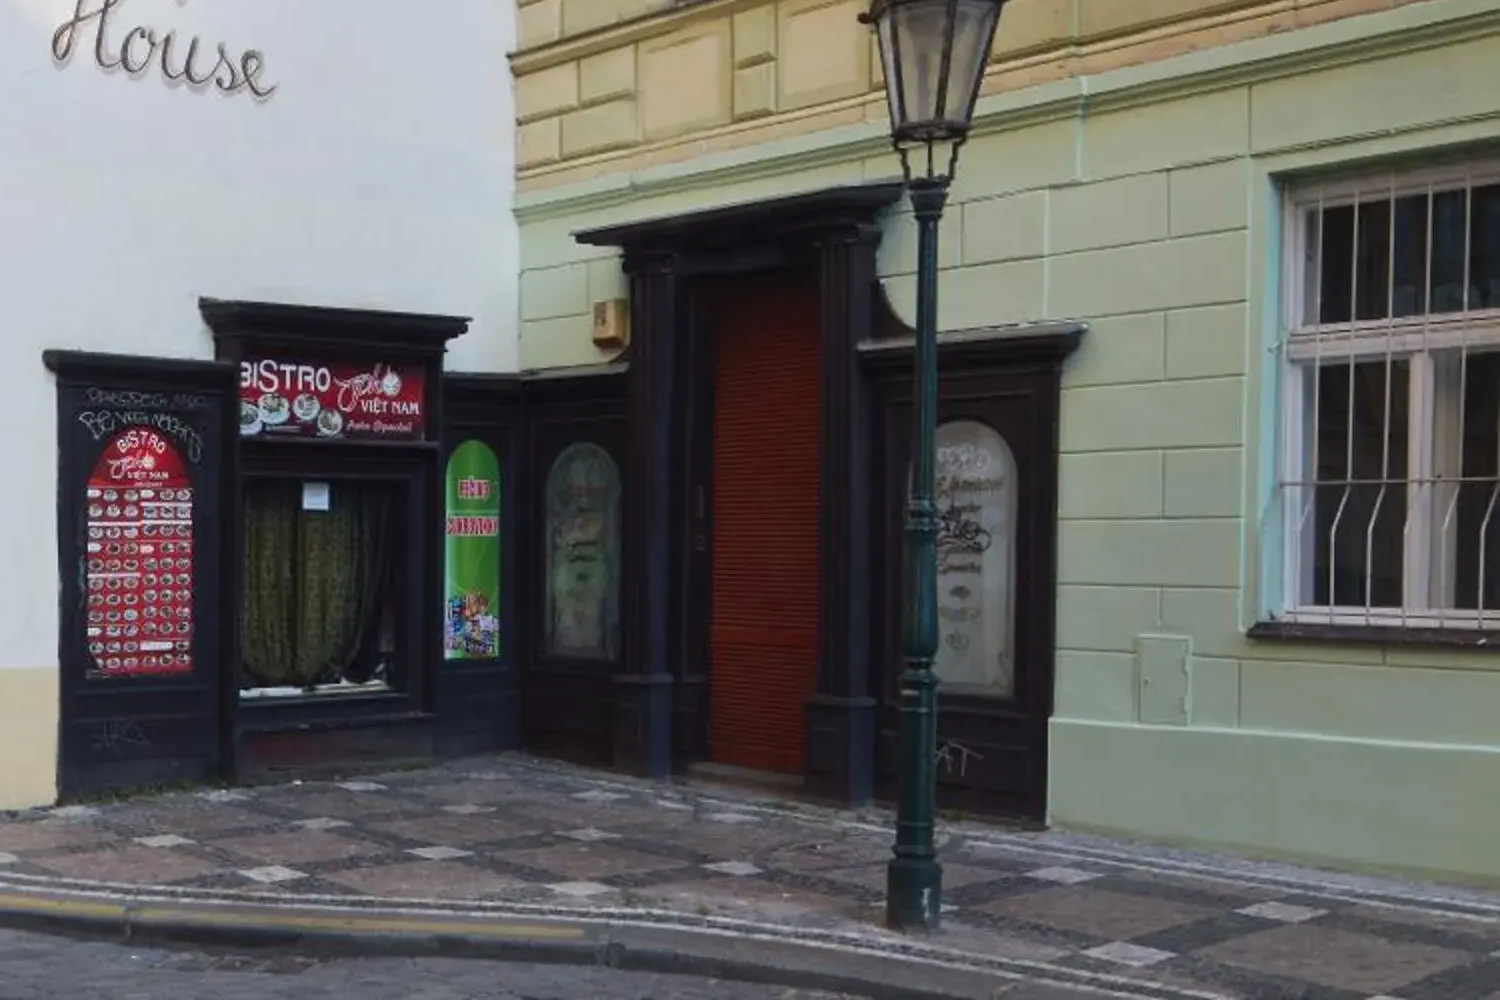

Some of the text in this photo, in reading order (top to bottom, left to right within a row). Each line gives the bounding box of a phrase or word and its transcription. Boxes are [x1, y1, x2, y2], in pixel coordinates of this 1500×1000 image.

[240, 359, 331, 393] BISTRO
[391, 400, 420, 416] NAM
[116, 429, 166, 454] BISTRO
